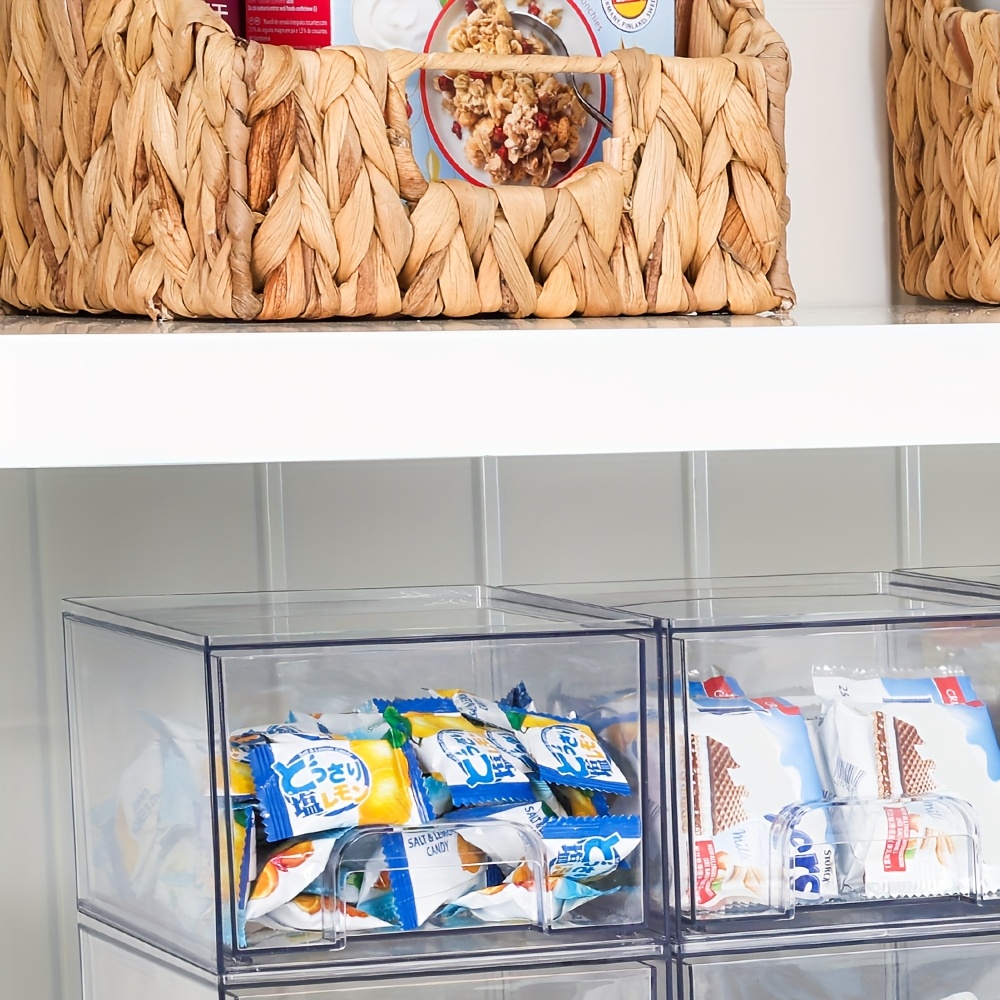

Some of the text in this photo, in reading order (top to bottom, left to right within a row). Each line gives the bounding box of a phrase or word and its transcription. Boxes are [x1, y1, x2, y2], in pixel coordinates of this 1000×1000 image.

[271, 754, 361, 795] どっさり
[288, 783, 370, 819] 塩レモン
[407, 834, 427, 849] SALT
[426, 840, 450, 857] CANDY
